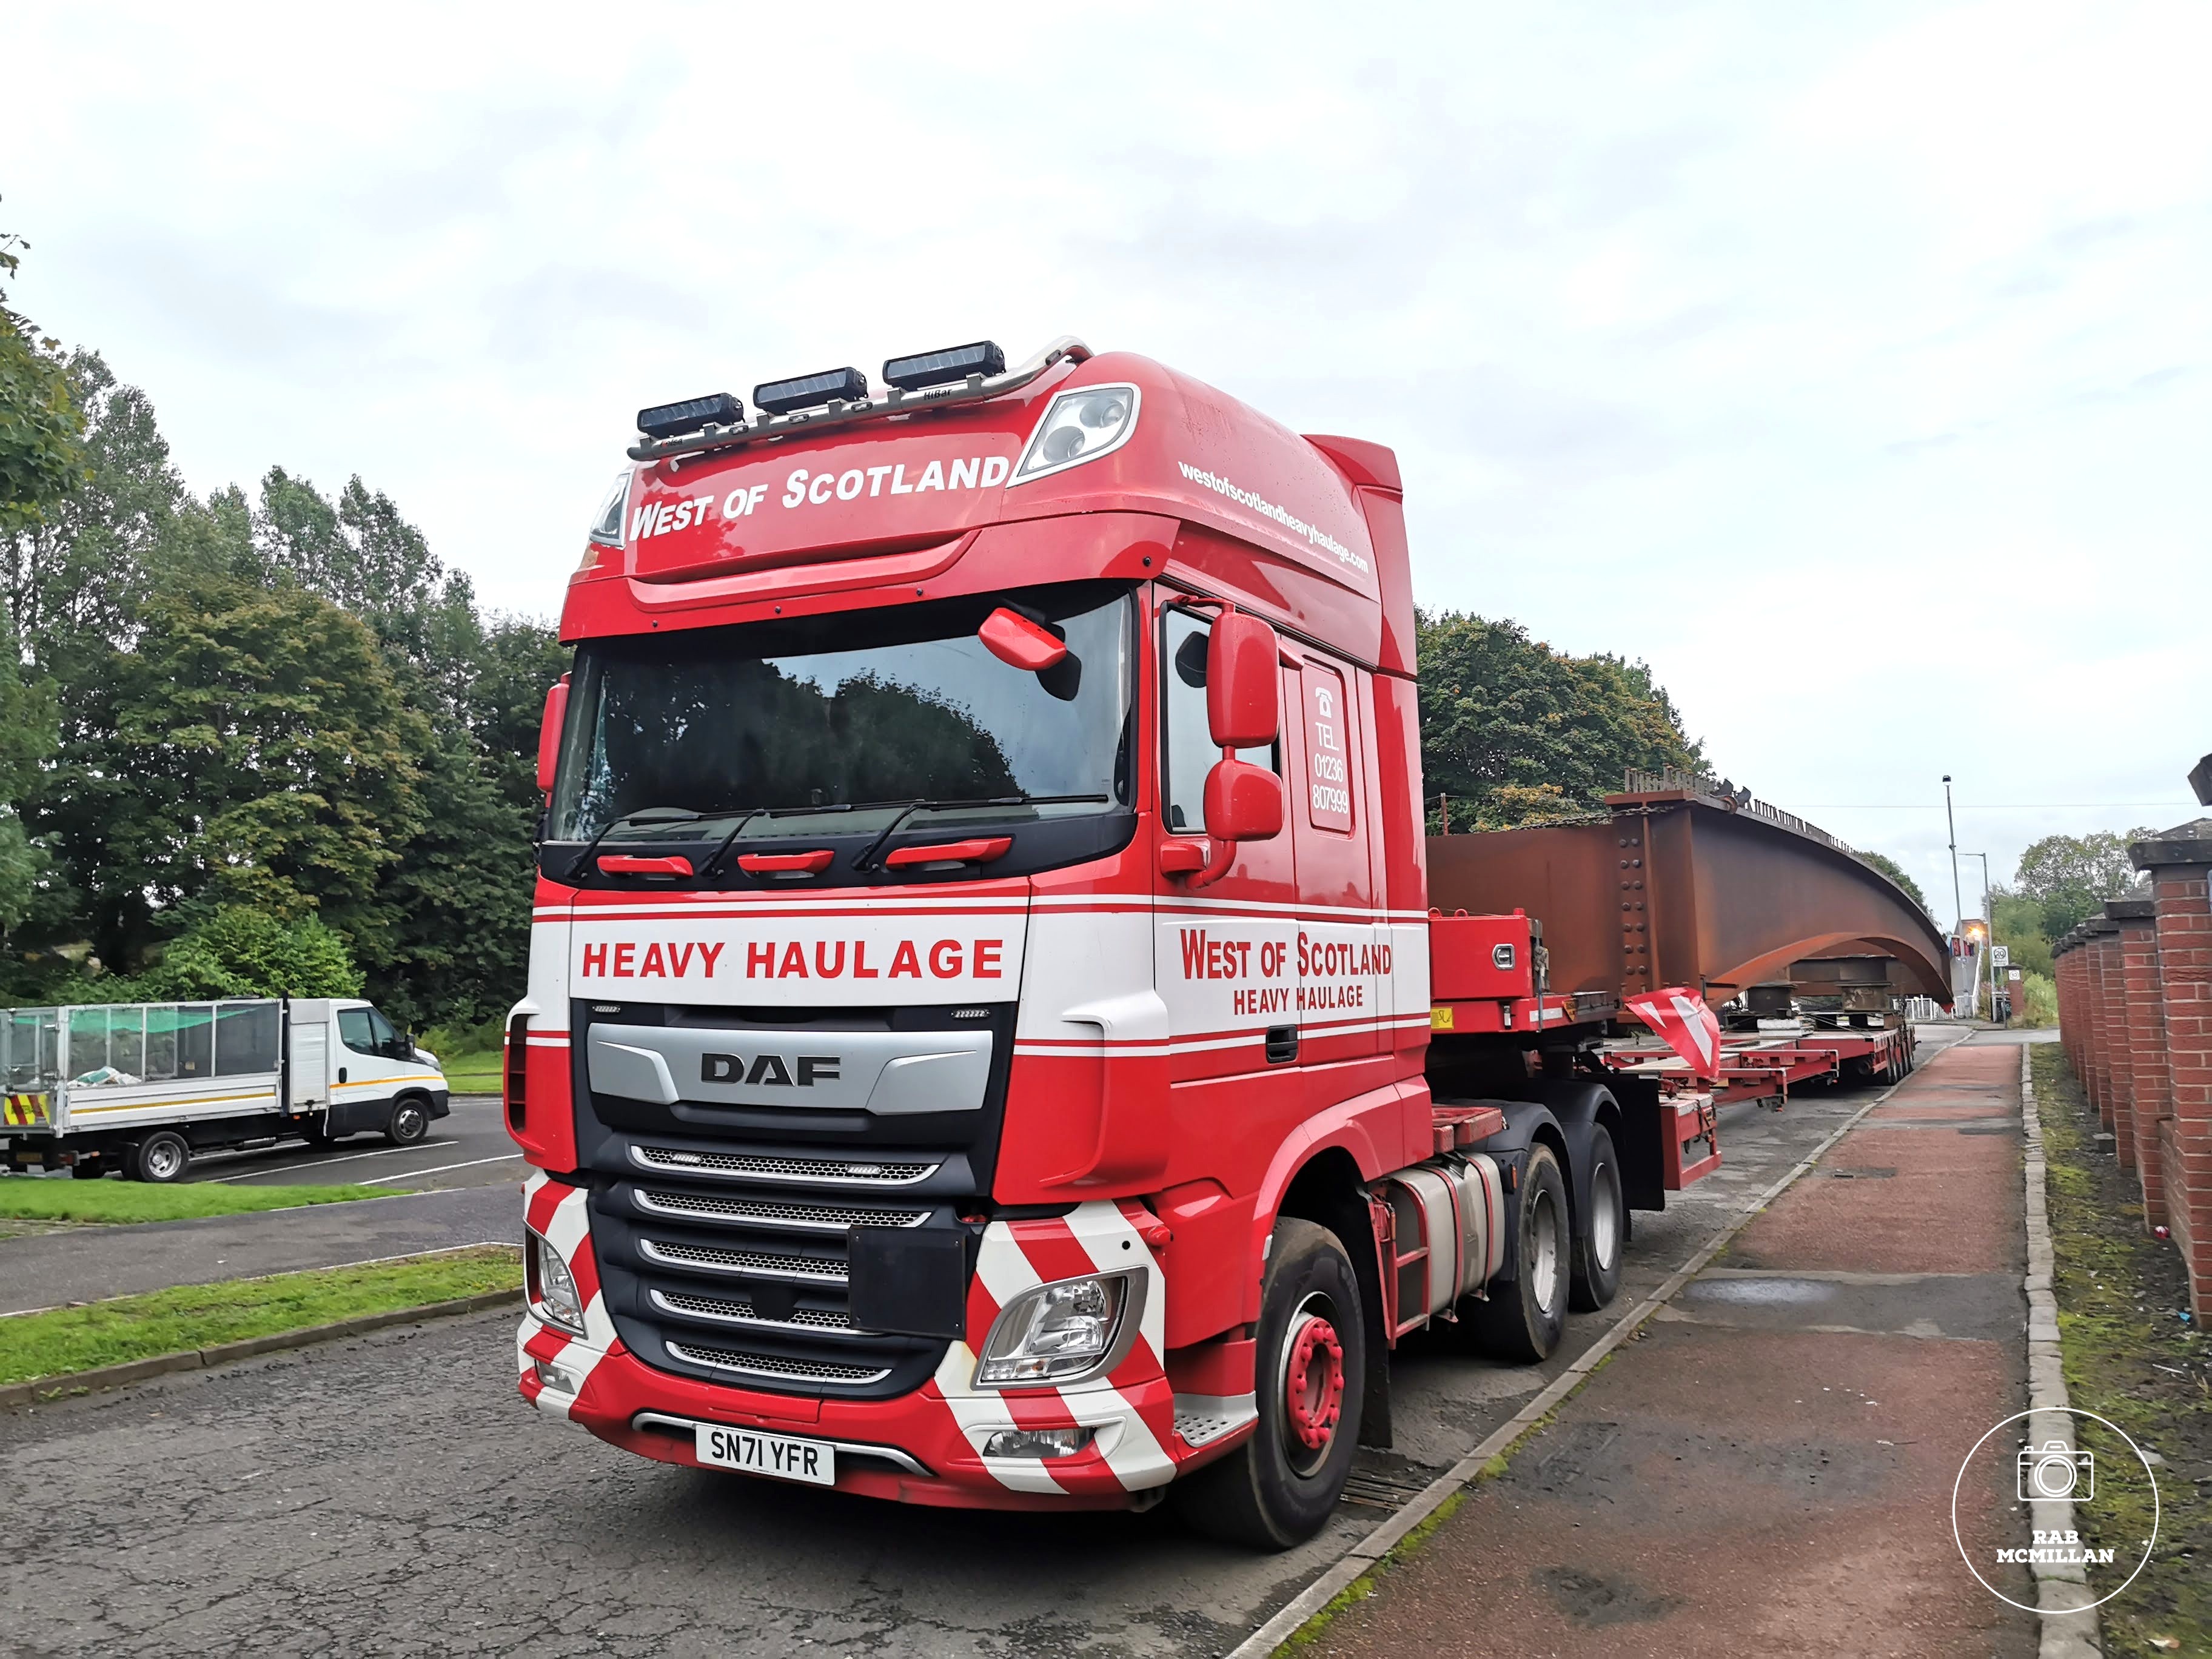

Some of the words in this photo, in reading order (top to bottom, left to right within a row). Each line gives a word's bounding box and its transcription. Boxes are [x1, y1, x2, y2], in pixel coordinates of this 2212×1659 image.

[629, 495, 713, 541] WEST
[723, 484, 768, 520] OF
[782, 456, 1009, 509] SCOTLAND
[1178, 461, 1369, 574] westofscotlandheavyhaulage.com
[1315, 722, 1339, 751] TEL.
[1315, 757, 1343, 782] 01236
[1313, 784, 1348, 814] 807999
[582, 942, 725, 977] HEAVY
[746, 939, 1003, 979] HAULAGE
[1181, 929, 1251, 979] WEST
[1261, 942, 1285, 977] OF
[1297, 931, 1391, 976] SCOTLAND
[1234, 988, 1289, 1015] HEAVY
[1297, 985, 1363, 1011] HAULAGE
[701, 1053, 840, 1087] DAF
[711, 1432, 762, 1466] SN71
[771, 1441, 817, 1476] YFR
